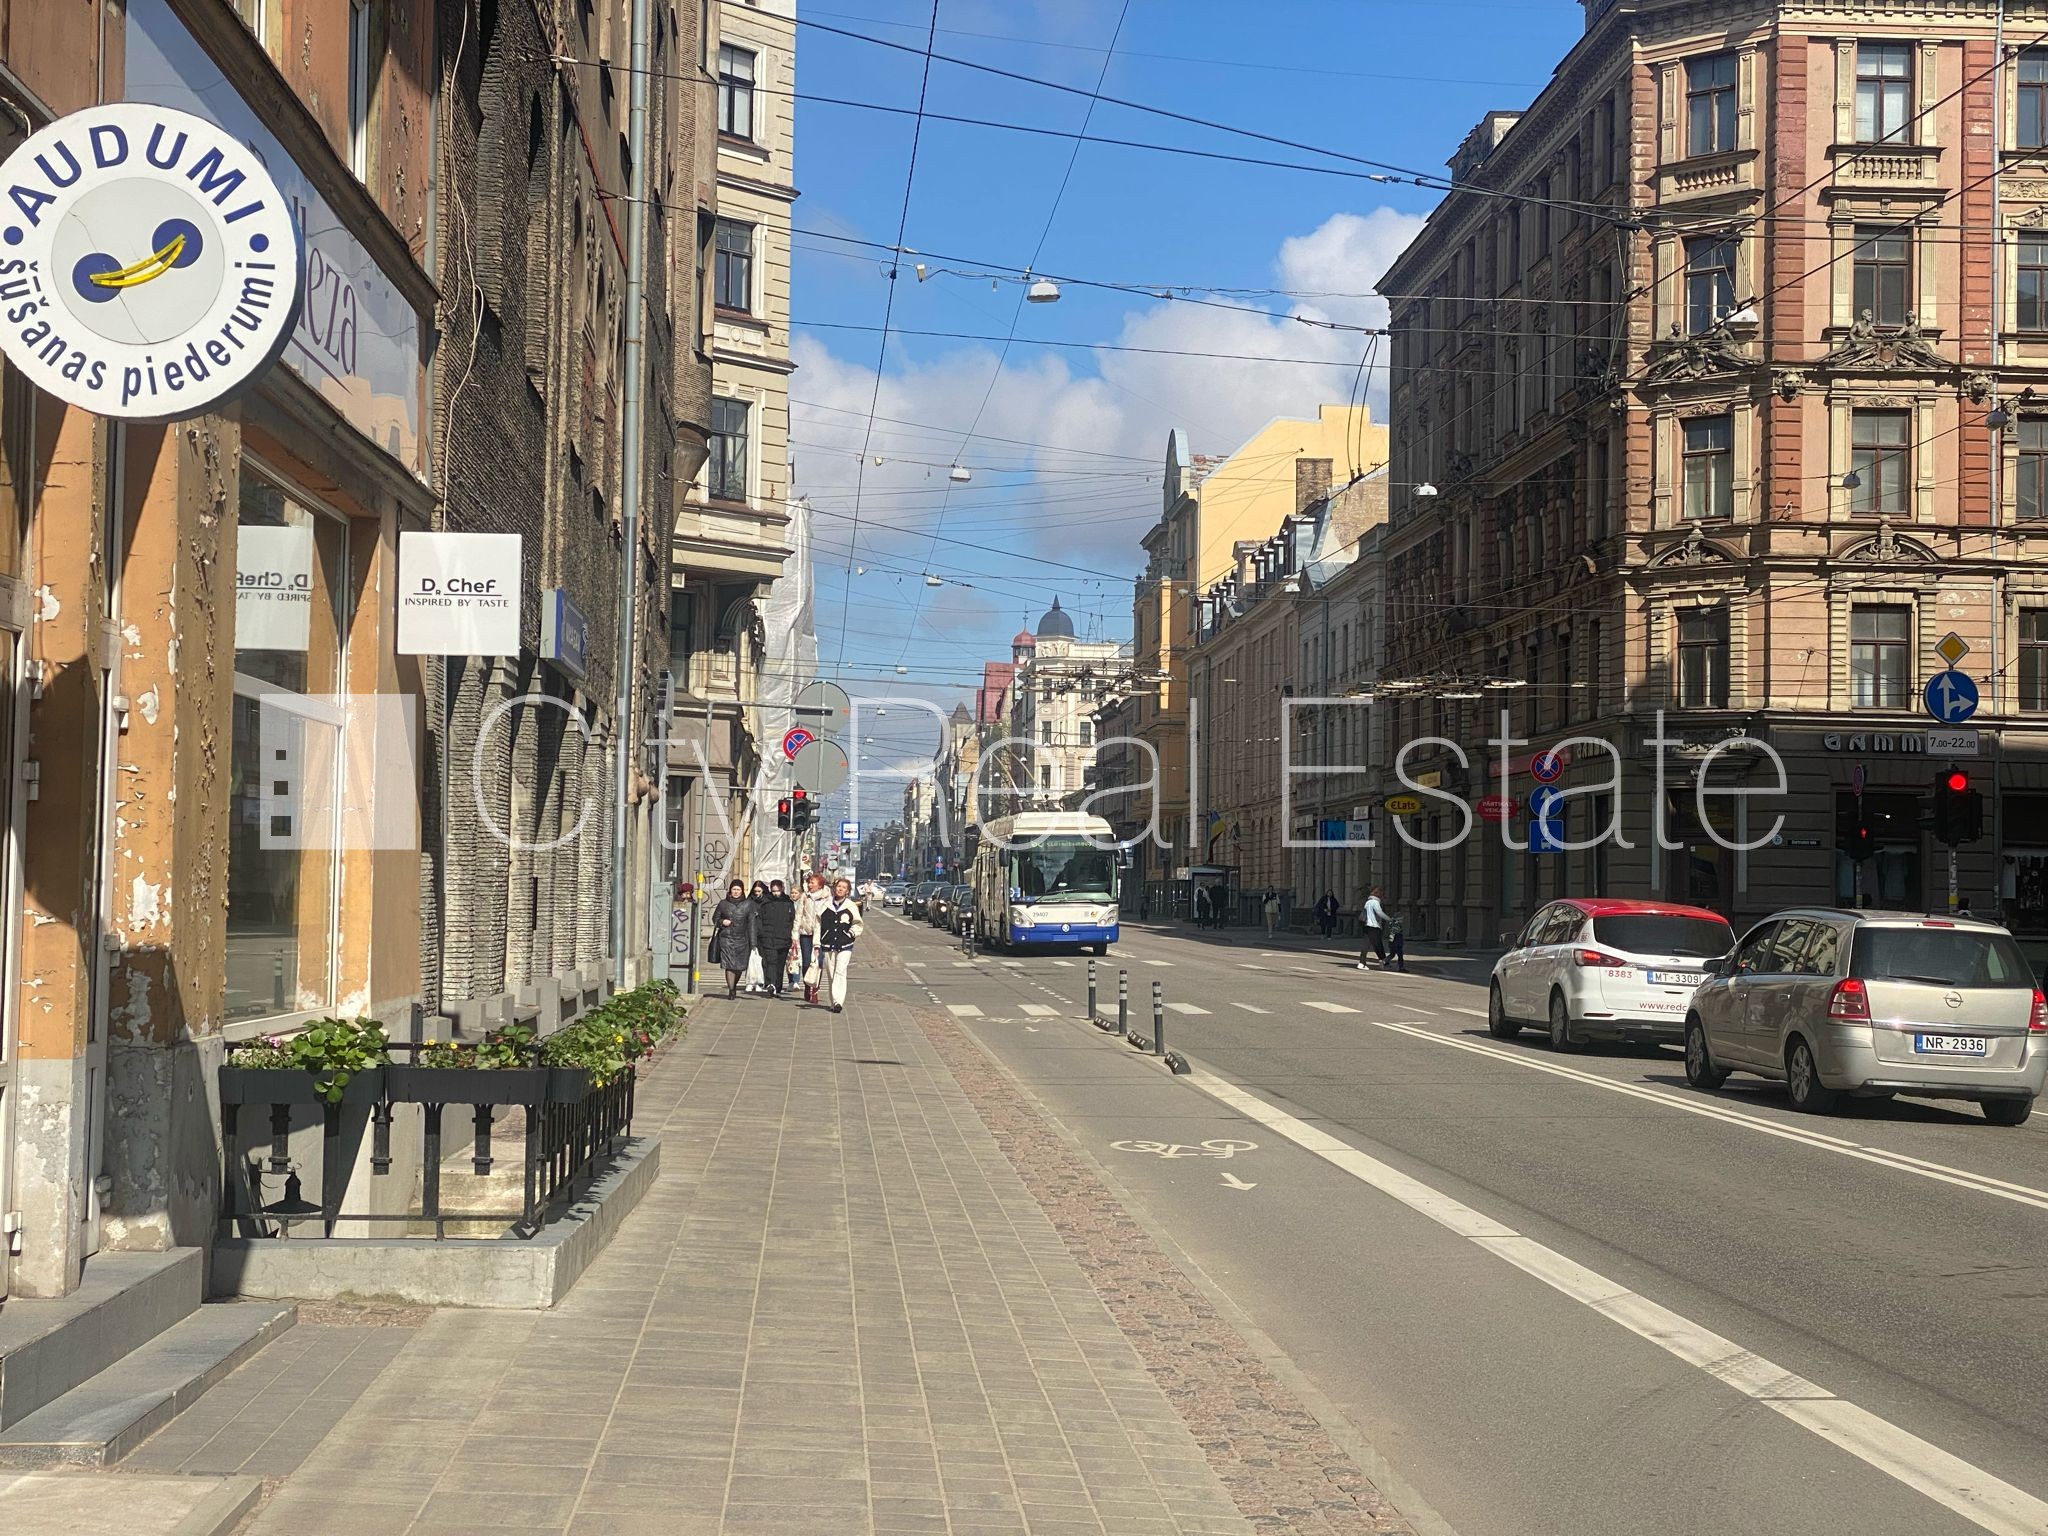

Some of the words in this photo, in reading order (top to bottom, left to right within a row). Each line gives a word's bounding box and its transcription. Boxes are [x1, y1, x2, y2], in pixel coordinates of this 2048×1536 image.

[7, 122, 265, 227] AUDUMI
[0, 260, 107, 390] šūšanas
[121, 260, 276, 407] piederumi
[404, 597, 452, 607] INSPIRED
[457, 599, 472, 607] BY
[478, 599, 509, 608] TASTE
[1930, 737, 1976, 749] 7.00-22.00
[1655, 973, 1699, 984] MT-3309
[1639, 1002, 1688, 1012] www.redc
[1925, 1036, 1984, 1051] NR-2936
